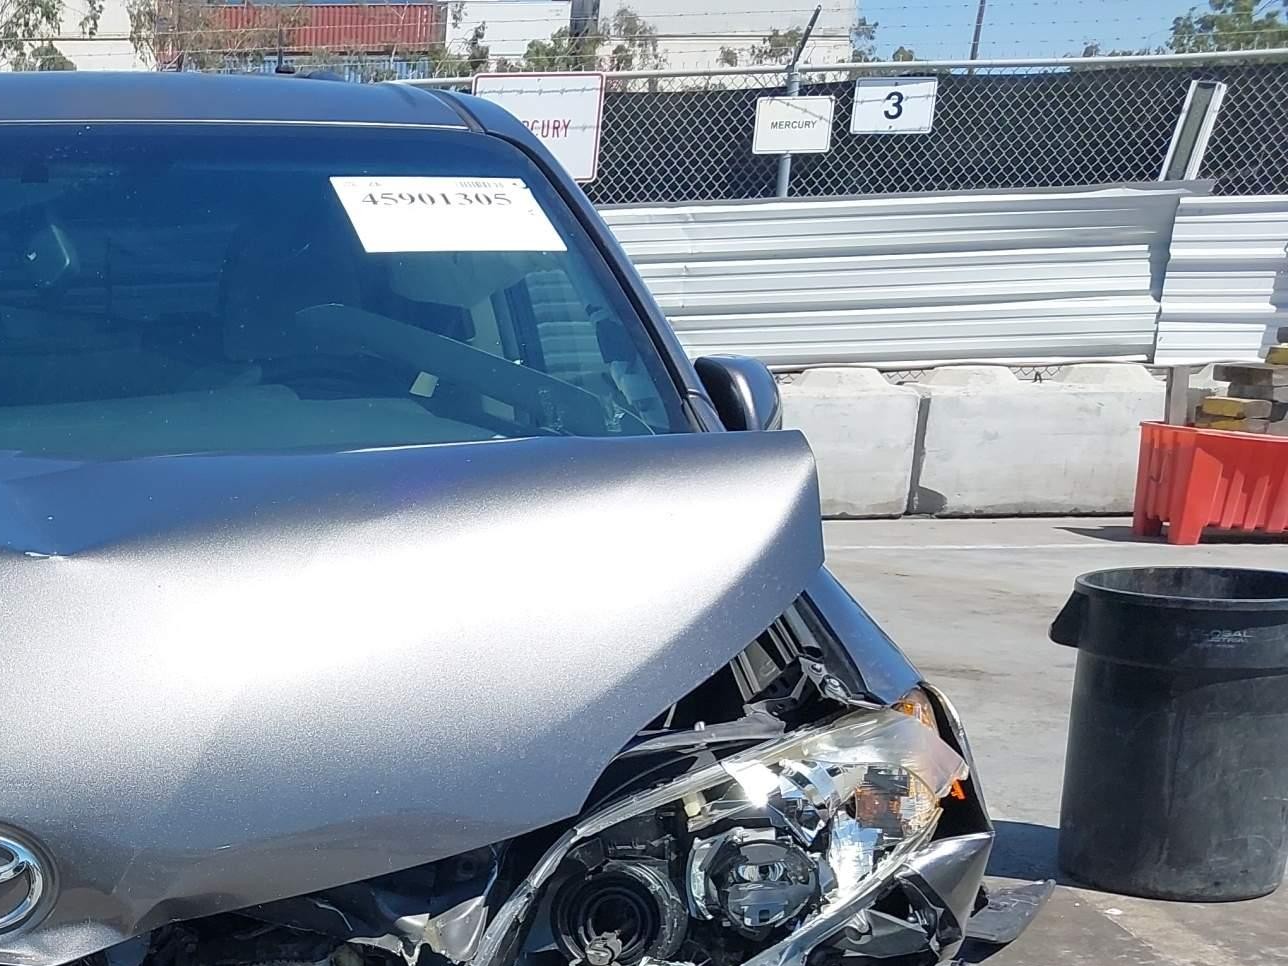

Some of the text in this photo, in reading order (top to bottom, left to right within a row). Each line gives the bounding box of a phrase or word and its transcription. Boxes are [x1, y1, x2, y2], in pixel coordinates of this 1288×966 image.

[883, 91, 904, 120] 3
[770, 120, 817, 130] MERCURY
[361, 192, 512, 206] 45901305
